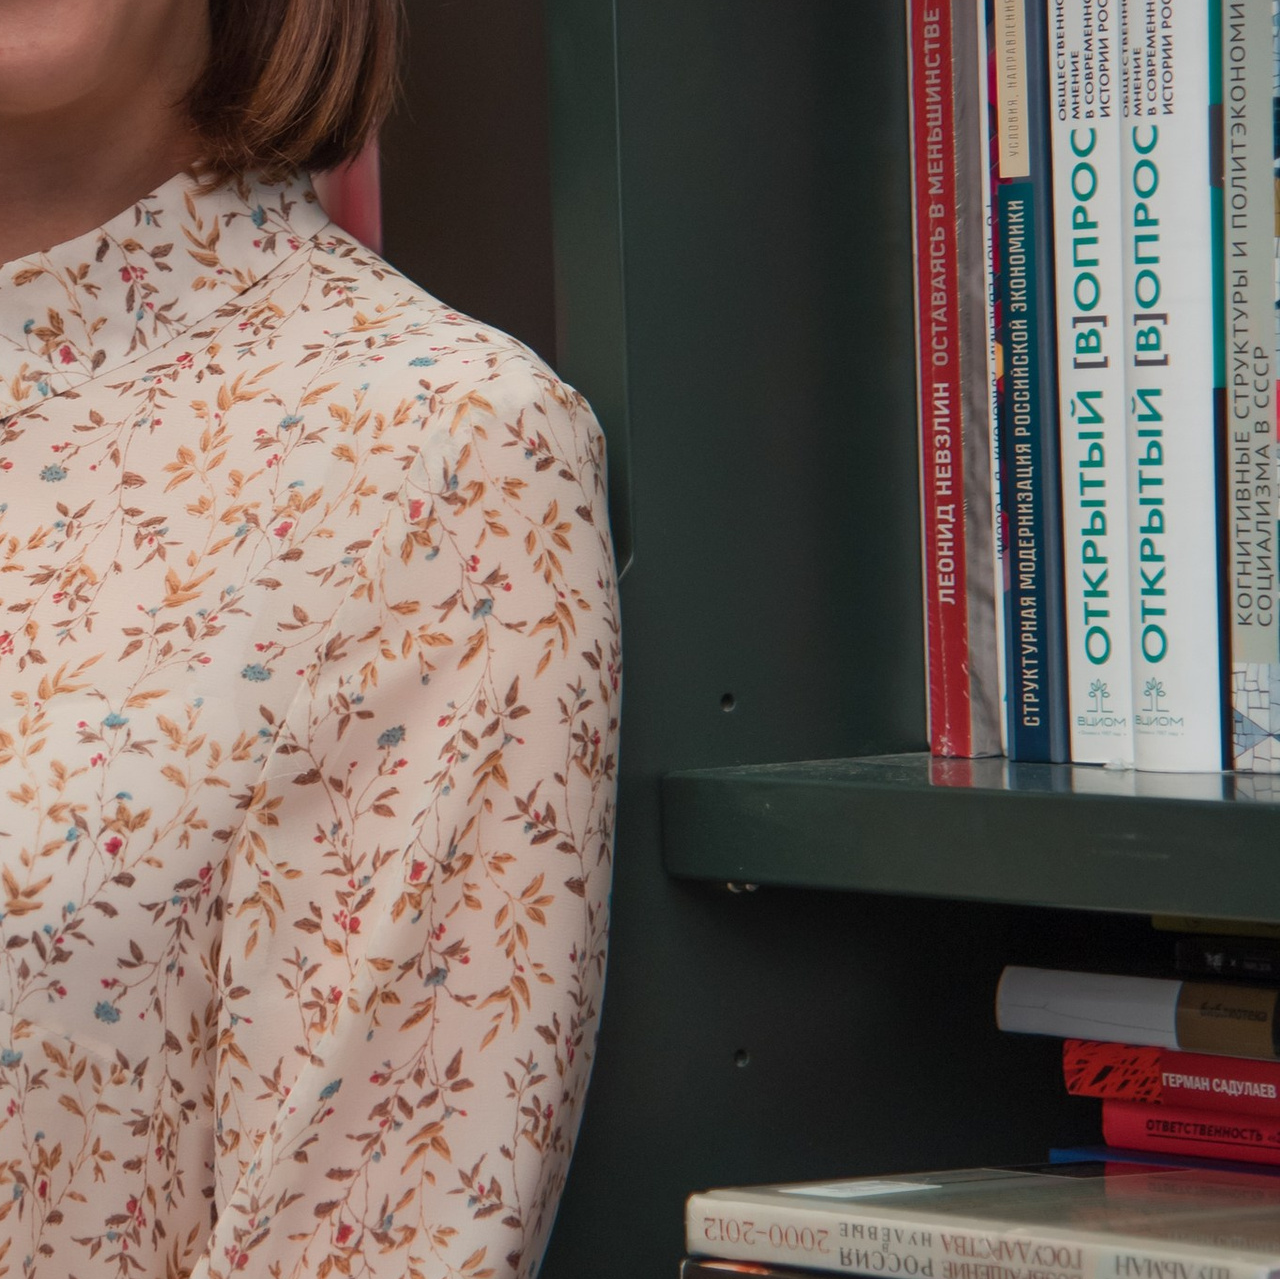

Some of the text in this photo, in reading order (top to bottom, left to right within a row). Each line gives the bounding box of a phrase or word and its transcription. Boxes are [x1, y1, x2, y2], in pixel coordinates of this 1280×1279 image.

[1070, 50, 1081, 120] МНЕНИЕ
[1097, 37, 1111, 118] ИСТОРИИ
[1132, 46, 1143, 117] МНЕНИЕ
[1160, 34, 1174, 115] ИСТОРИИ
[1085, 111, 1095, 119] В
[1146, 108, 1157, 116] В
[923, 7, 949, 367] ОСТАВАЯСЬ В МЕНЬШИНСТВЕ
[1233, 241, 1248, 258] И
[1231, 269, 1250, 420] СТРУКТУРЫ
[1070, 127, 1111, 666] ОТКРЫТЫЙ [В]ОПРОС
[1131, 124, 1169, 664] ОТКРЫТЫЙ [В]ОПРОС
[932, 382, 955, 606] ЛЕОНИД НЕВЗЛИН
[1007, 199, 1040, 727] СТРУКТУРНАЯ МОДЕРНИЗАЦИЯ РОССИЙСКОЙ ЭКОНОМИКИ
[1253, 346, 1275, 627] СОЦИАЛИЗМА В СССР
[1234, 430, 1252, 626] КОГНИТИВНЫЕ
[1077, 715, 1127, 728] ВЦИОМ
[1162, 1072, 1278, 1099] ГЕРМАН САДУЛАЕВ
[1145, 1119, 1263, 1141] ОТВЕТСТВЕННОСТЬ
[839, 1222, 933, 1248] НУЛЕВЫЕ
[840, 1247, 934, 1277] РОССИЯ
[940, 1233, 1084, 1270] ГОСУДАРСТВА
